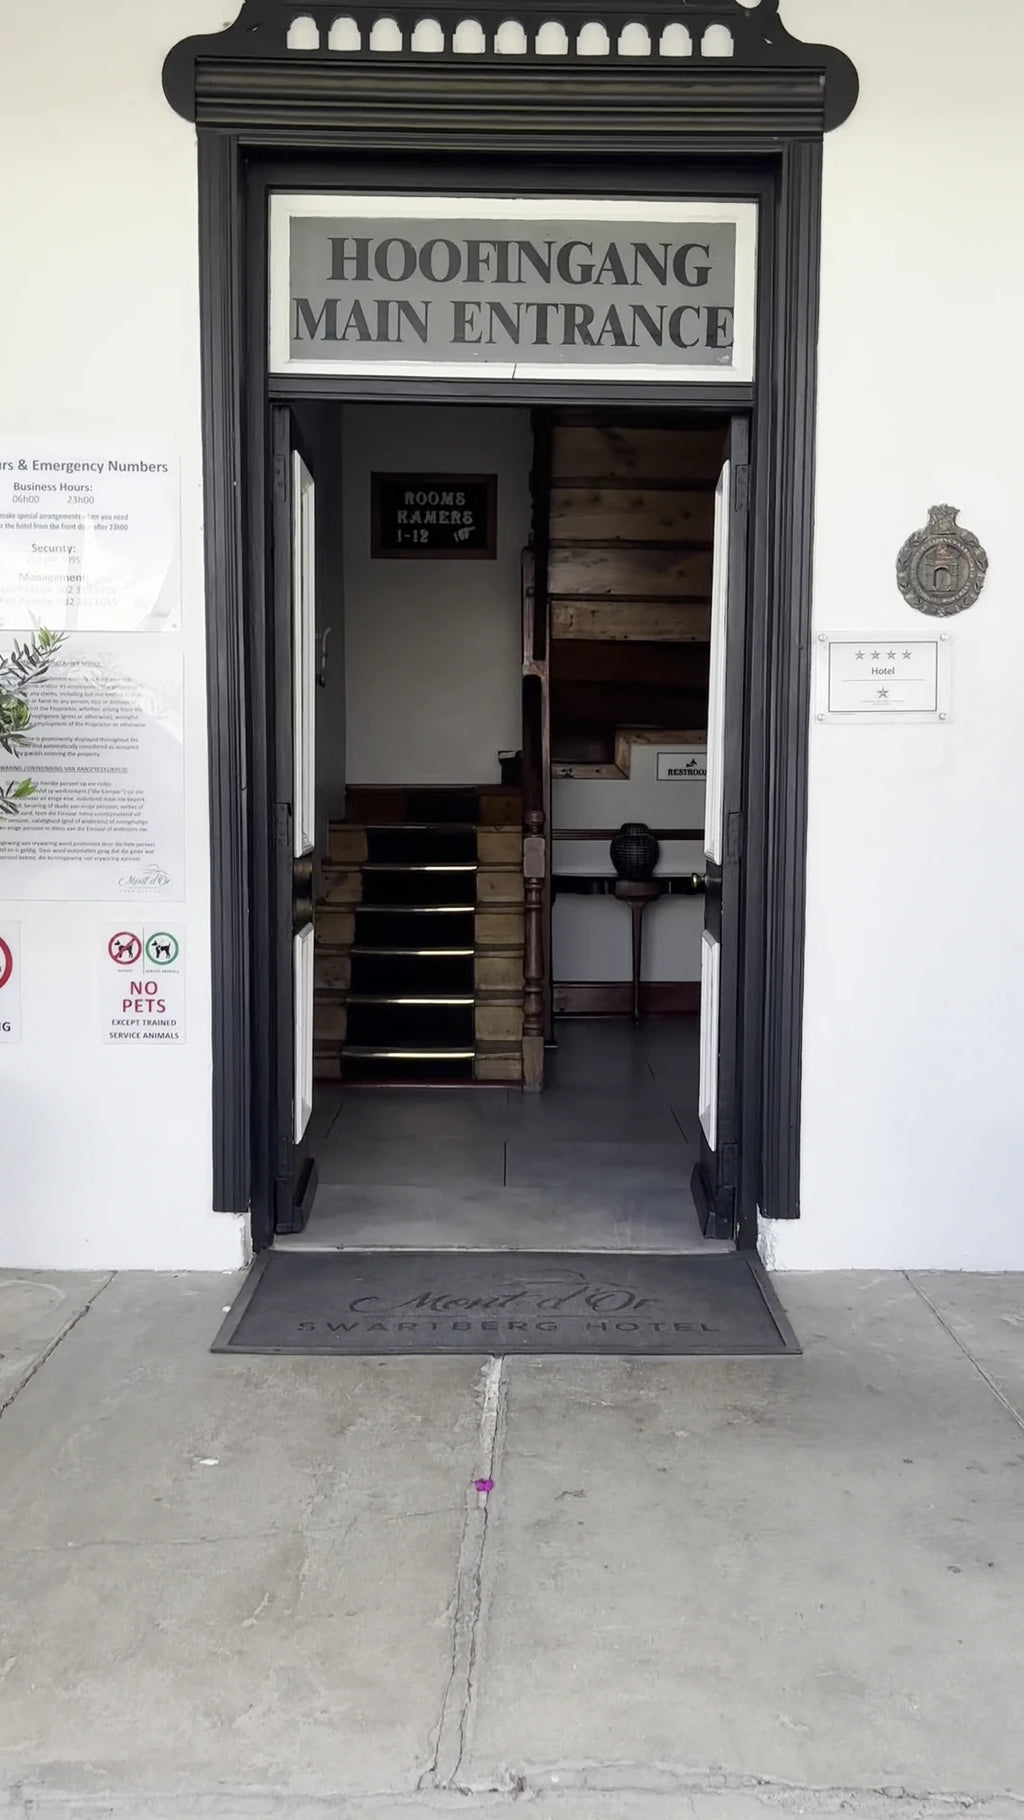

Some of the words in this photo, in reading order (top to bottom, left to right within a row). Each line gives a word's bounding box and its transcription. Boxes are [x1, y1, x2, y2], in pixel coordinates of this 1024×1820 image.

[326, 238, 711, 288] HOOFINGANG
[291, 298, 432, 341] MAIN
[449, 301, 736, 349] ENTRANCE
[18, 459, 28, 472] &
[32, 460, 104, 475] Emergency
[108, 461, 168, 473] Numbers
[13, 482, 57, 492] Business
[59, 483, 94, 493] Hours:
[12, 495, 40, 504] 06h00
[67, 496, 95, 505] 23h00
[404, 491, 466, 506] ROOMS
[17, 513, 38, 521] special
[397, 529, 429, 543] 1-12
[31, 543, 77, 555] Security:
[871, 666, 896, 676] Hotel
[130, 981, 158, 996] NO
[122, 998, 166, 1013] PETS
[142, 1019, 177, 1027] TRAINED
[142, 1032, 180, 1040] ANIMALS
[350, 1290, 529, 1313] Mont
[297, 1321, 560, 1333] SWARTBERG
[586, 1321, 720, 1333] HOTEL
